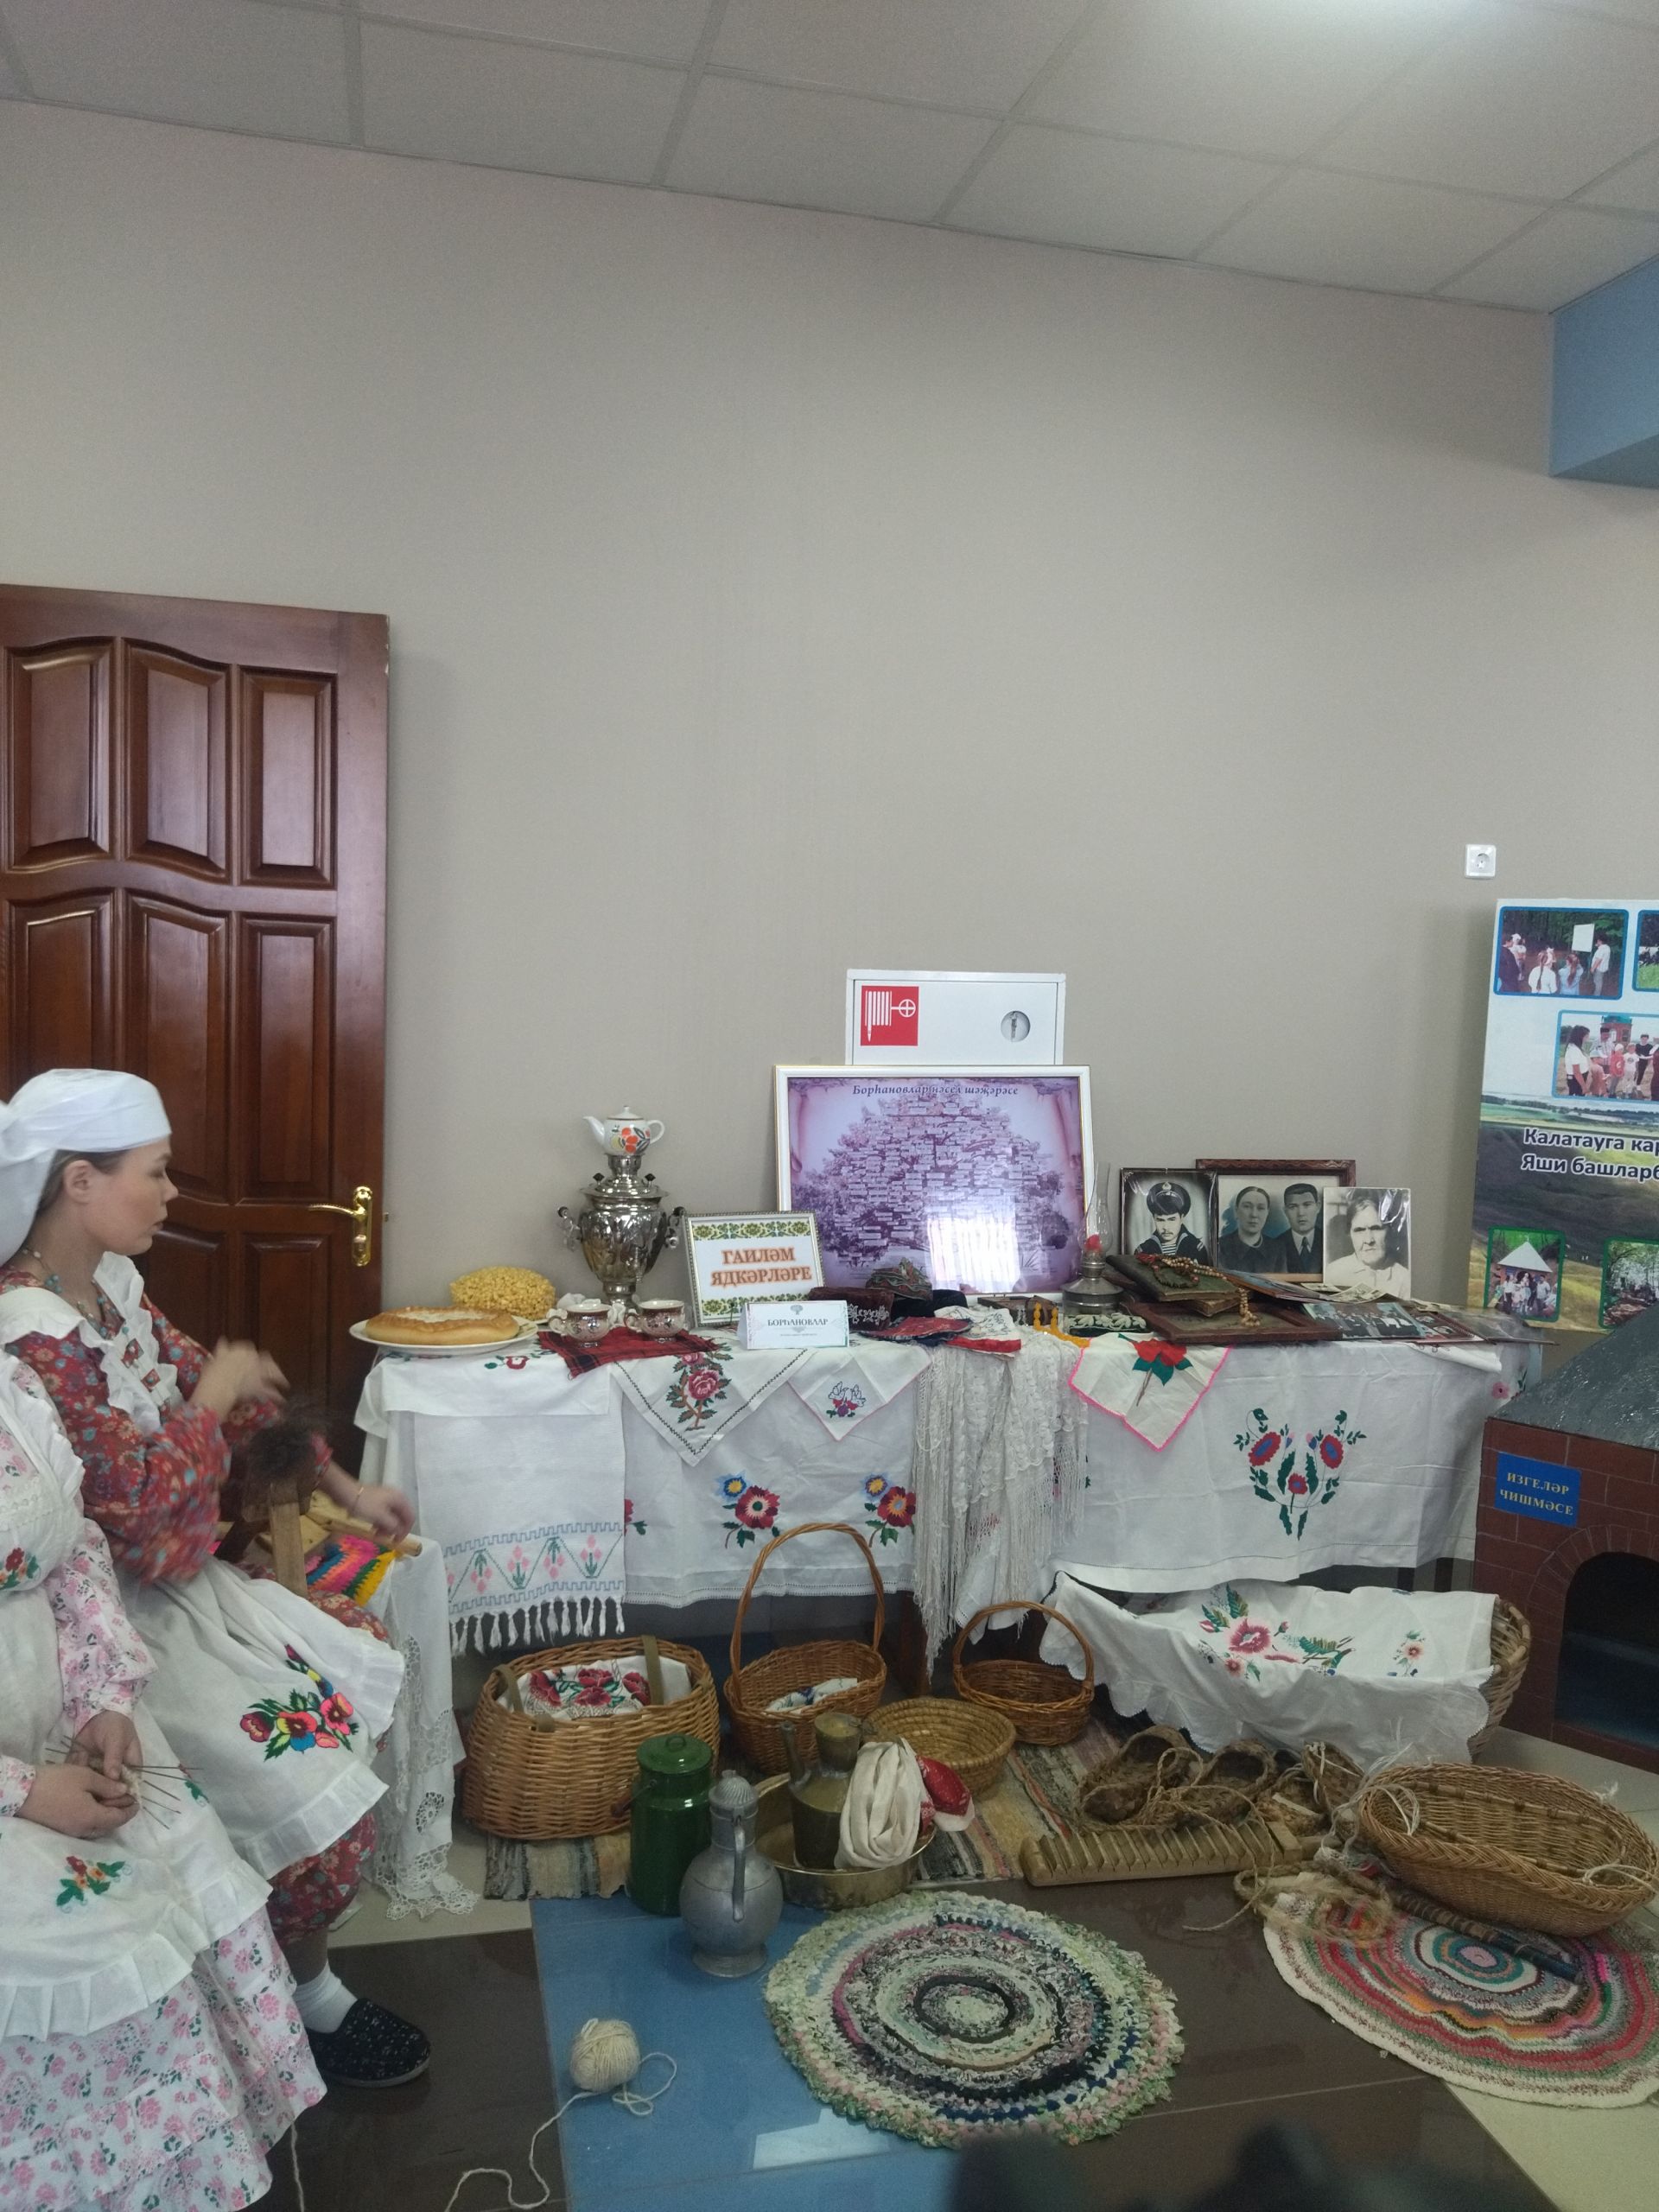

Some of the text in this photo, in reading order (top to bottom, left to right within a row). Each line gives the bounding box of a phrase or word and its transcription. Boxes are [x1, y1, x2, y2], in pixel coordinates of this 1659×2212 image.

[1523, 1128, 1624, 1153] Калатауга
[1522, 1154, 1567, 1173] Яши
[722, 1248, 796, 1265] ГАИЛӘМ
[711, 1266, 813, 1288] ЯДКӘРЛӘРЕ
[1507, 1471, 1570, 1495] ИЗГЕЛӘР
[1499, 1489, 1573, 1516] ЧИШМӘСЕ
